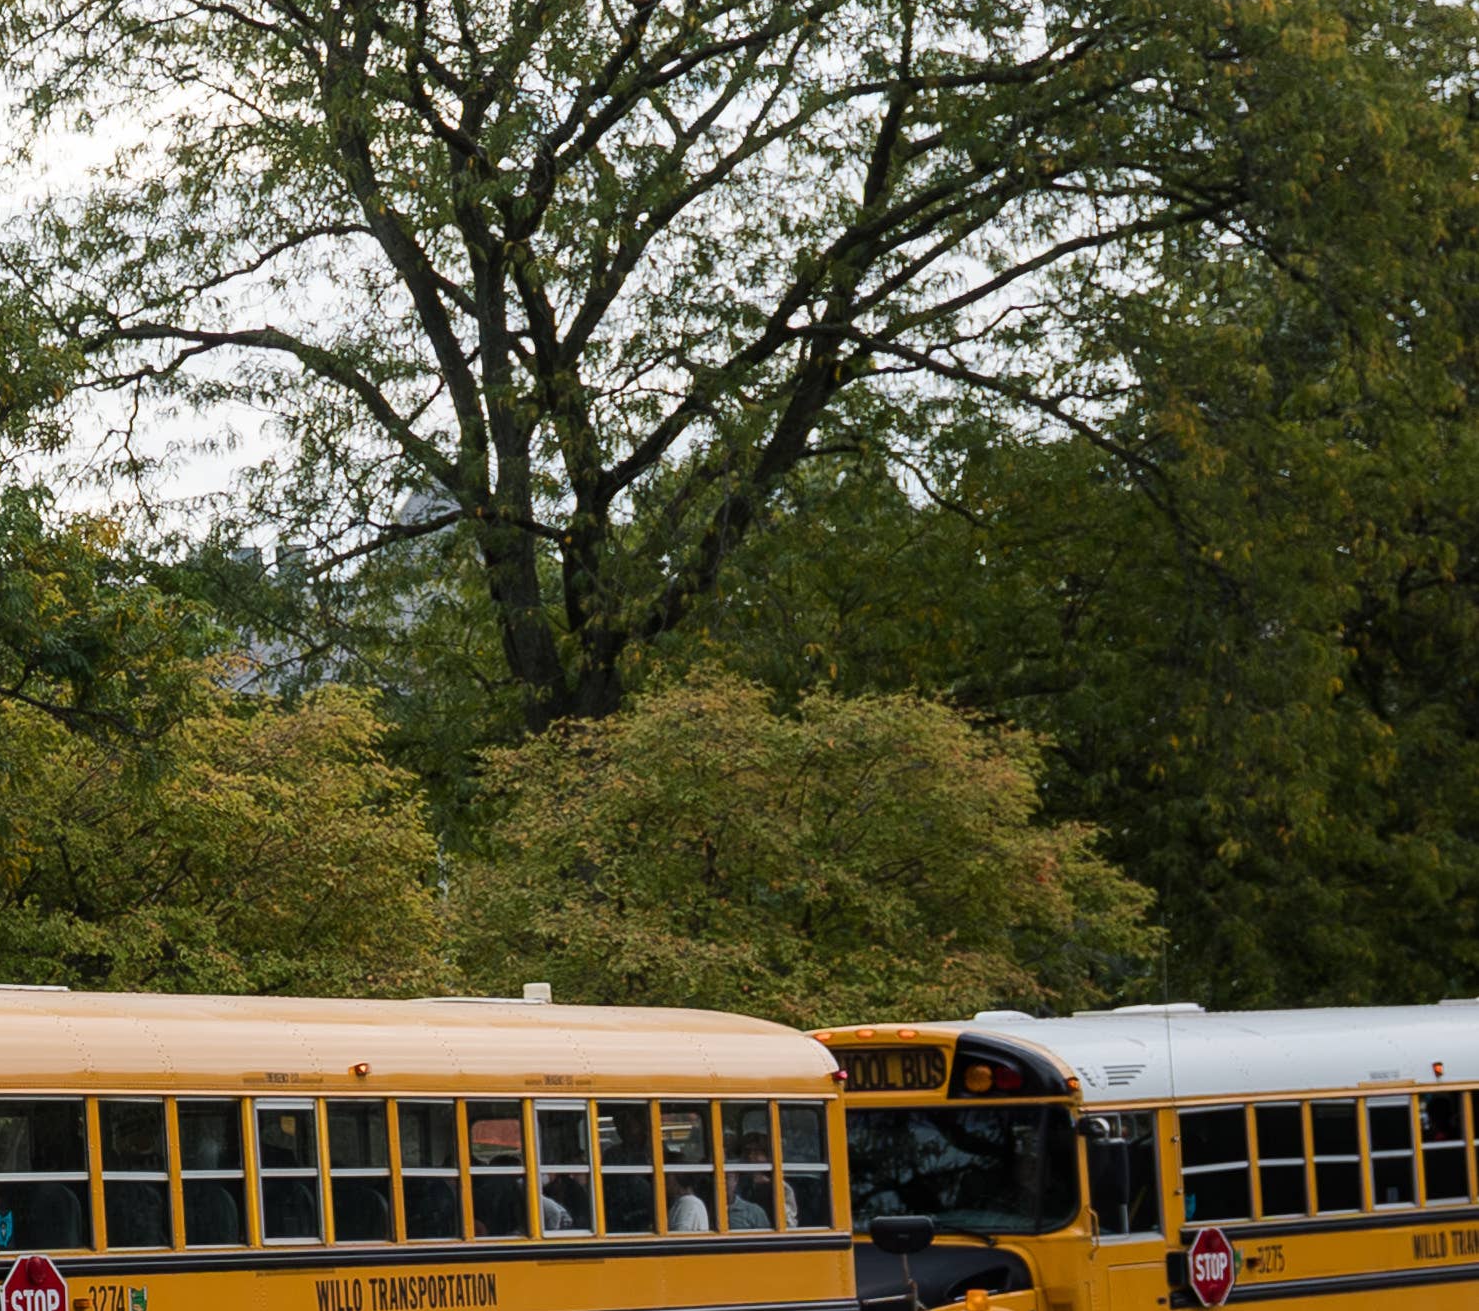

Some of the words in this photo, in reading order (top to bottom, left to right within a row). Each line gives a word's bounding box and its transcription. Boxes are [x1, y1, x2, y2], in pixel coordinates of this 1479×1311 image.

[902, 1053, 946, 1088] BUS
[1195, 1252, 1228, 1282] STOP
[368, 1272, 498, 1311] TRANSPORTATION
